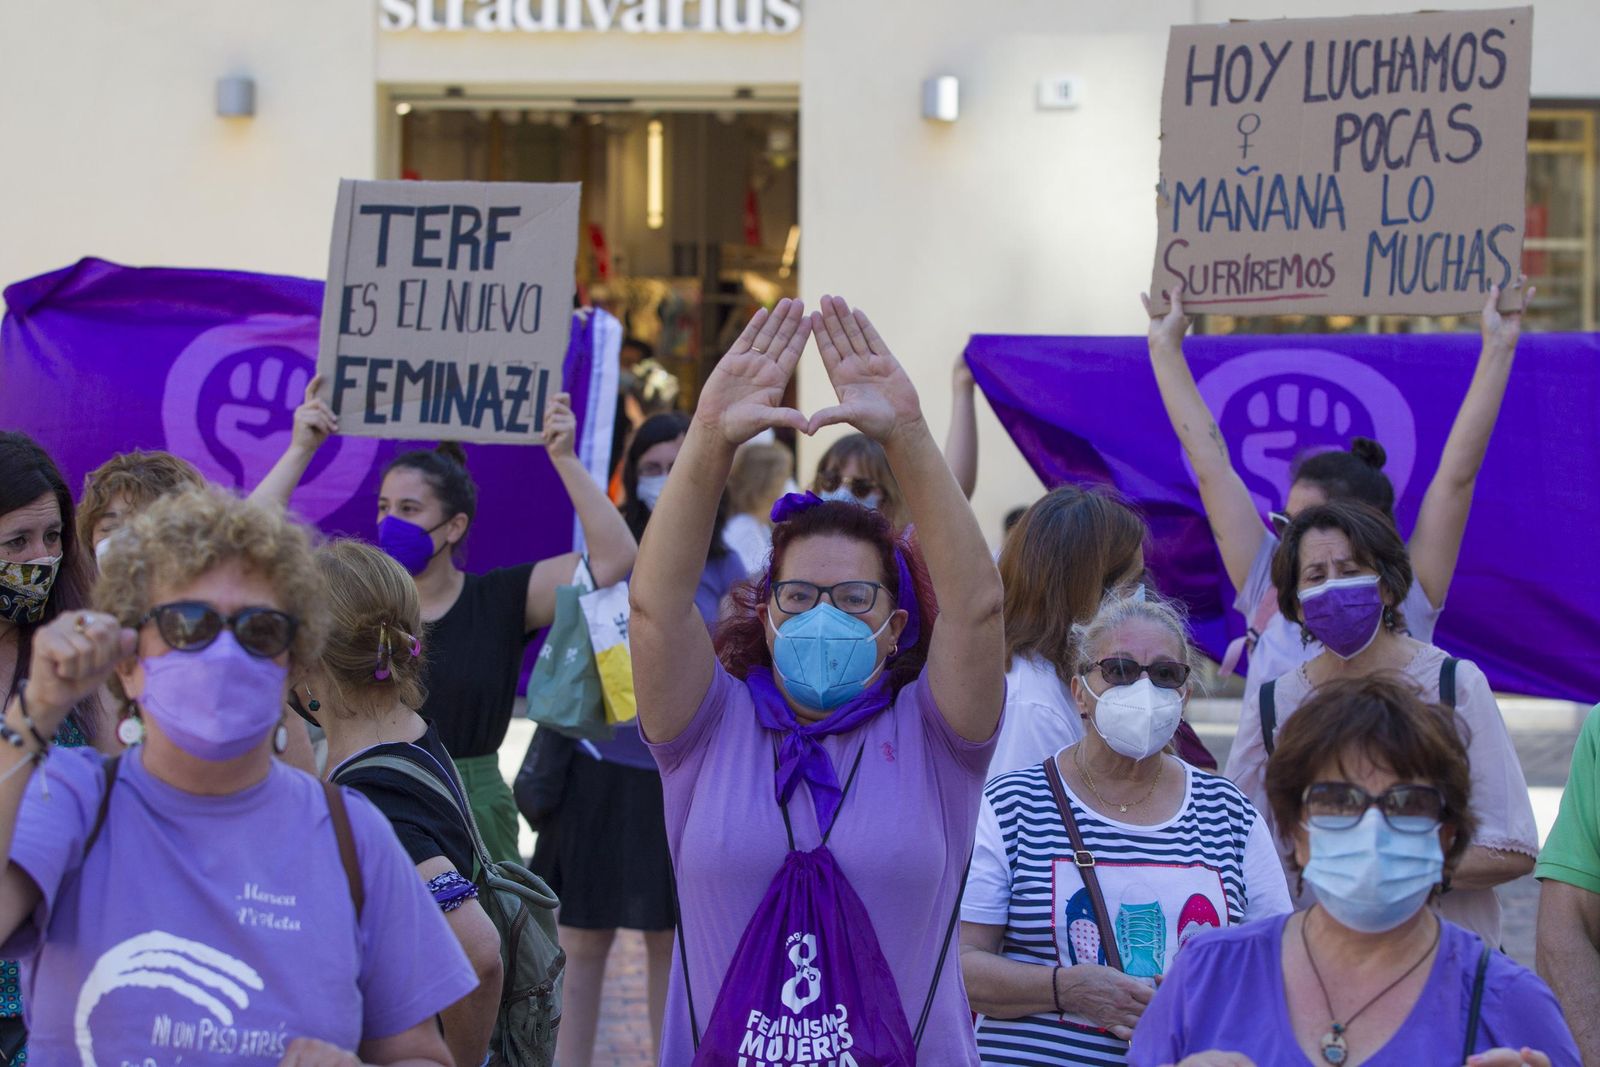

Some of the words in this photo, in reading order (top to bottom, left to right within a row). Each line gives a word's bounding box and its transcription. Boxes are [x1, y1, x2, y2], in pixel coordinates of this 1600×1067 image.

[1185, 40, 1293, 106] HOY
[1303, 28, 1507, 104] LUCHAMOS
[1333, 103, 1483, 173] POCAS
[1172, 165, 1346, 233] MAÑANA
[1381, 174, 1435, 227] LO
[359, 204, 522, 272] TERF
[1362, 224, 1516, 298] MUCHAS
[340, 282, 378, 337] ES
[397, 279, 432, 332] EL
[441, 279, 543, 334] NUEVO
[331, 355, 550, 434] FEMINAZI
[197, 1017, 238, 1055] PASO
